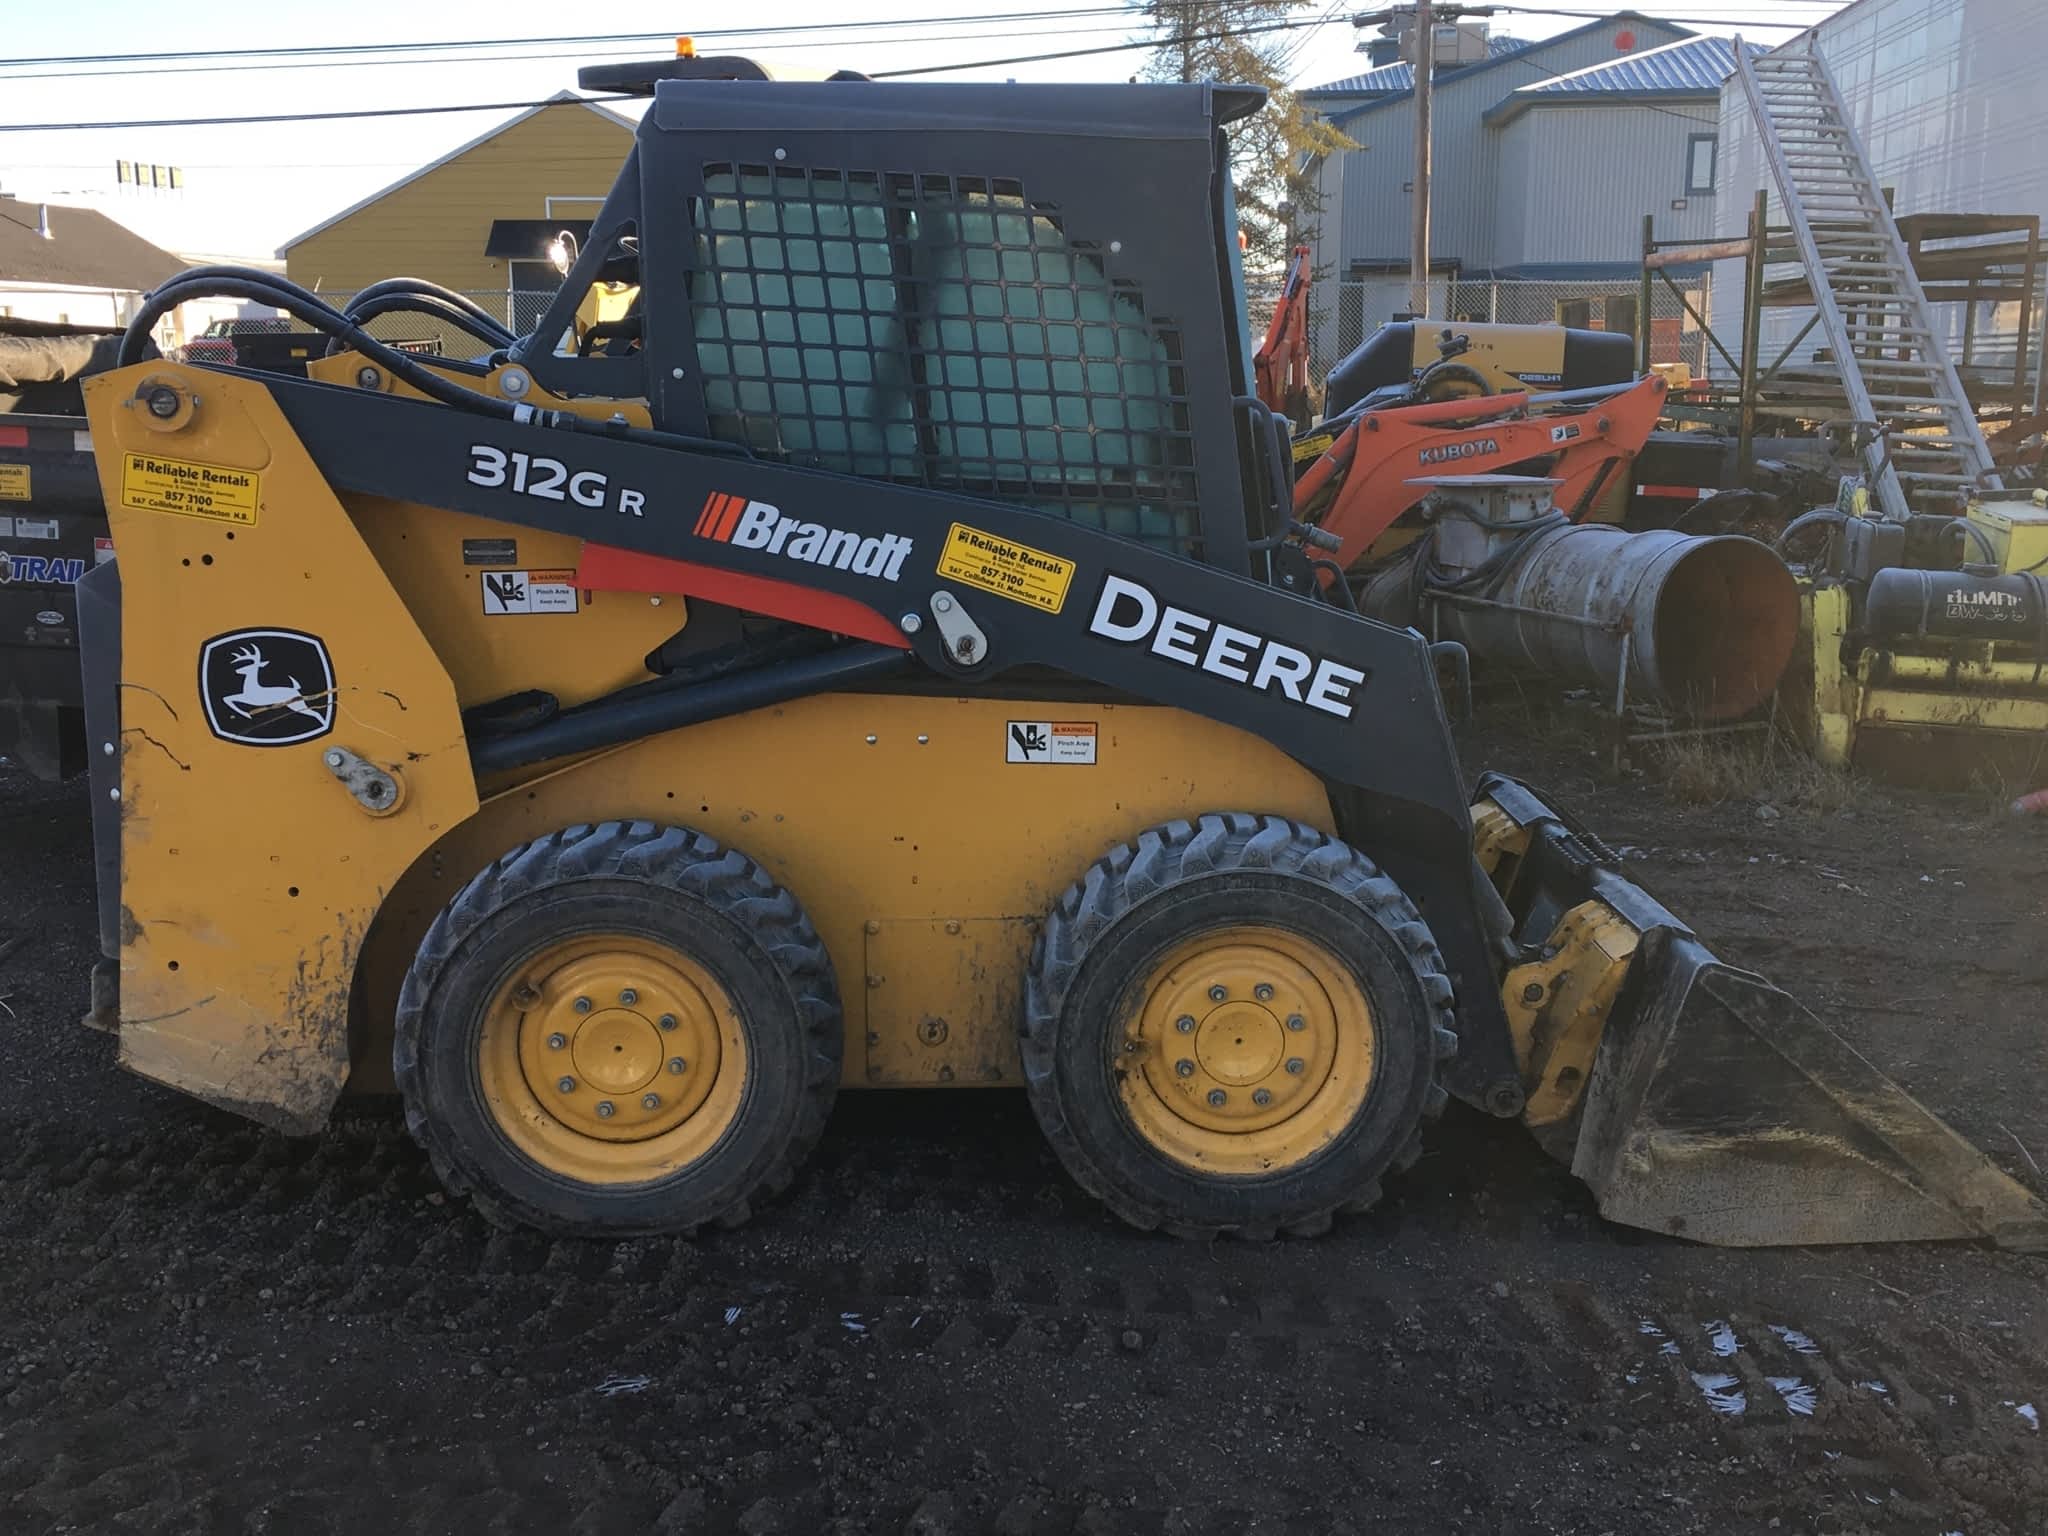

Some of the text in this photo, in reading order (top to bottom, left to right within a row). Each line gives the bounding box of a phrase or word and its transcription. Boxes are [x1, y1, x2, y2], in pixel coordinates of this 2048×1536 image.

[1419, 440, 1499, 465] KUBOTA
[146, 461, 249, 487] Reliable Rentals
[467, 445, 646, 516] 312G R
[731, 500, 914, 582] Brandt
[969, 534, 1017, 561] Reliable
[1019, 552, 1063, 575] Rentals
[980, 565, 1024, 586] 857-3100
[1090, 575, 1366, 718] DEERE
